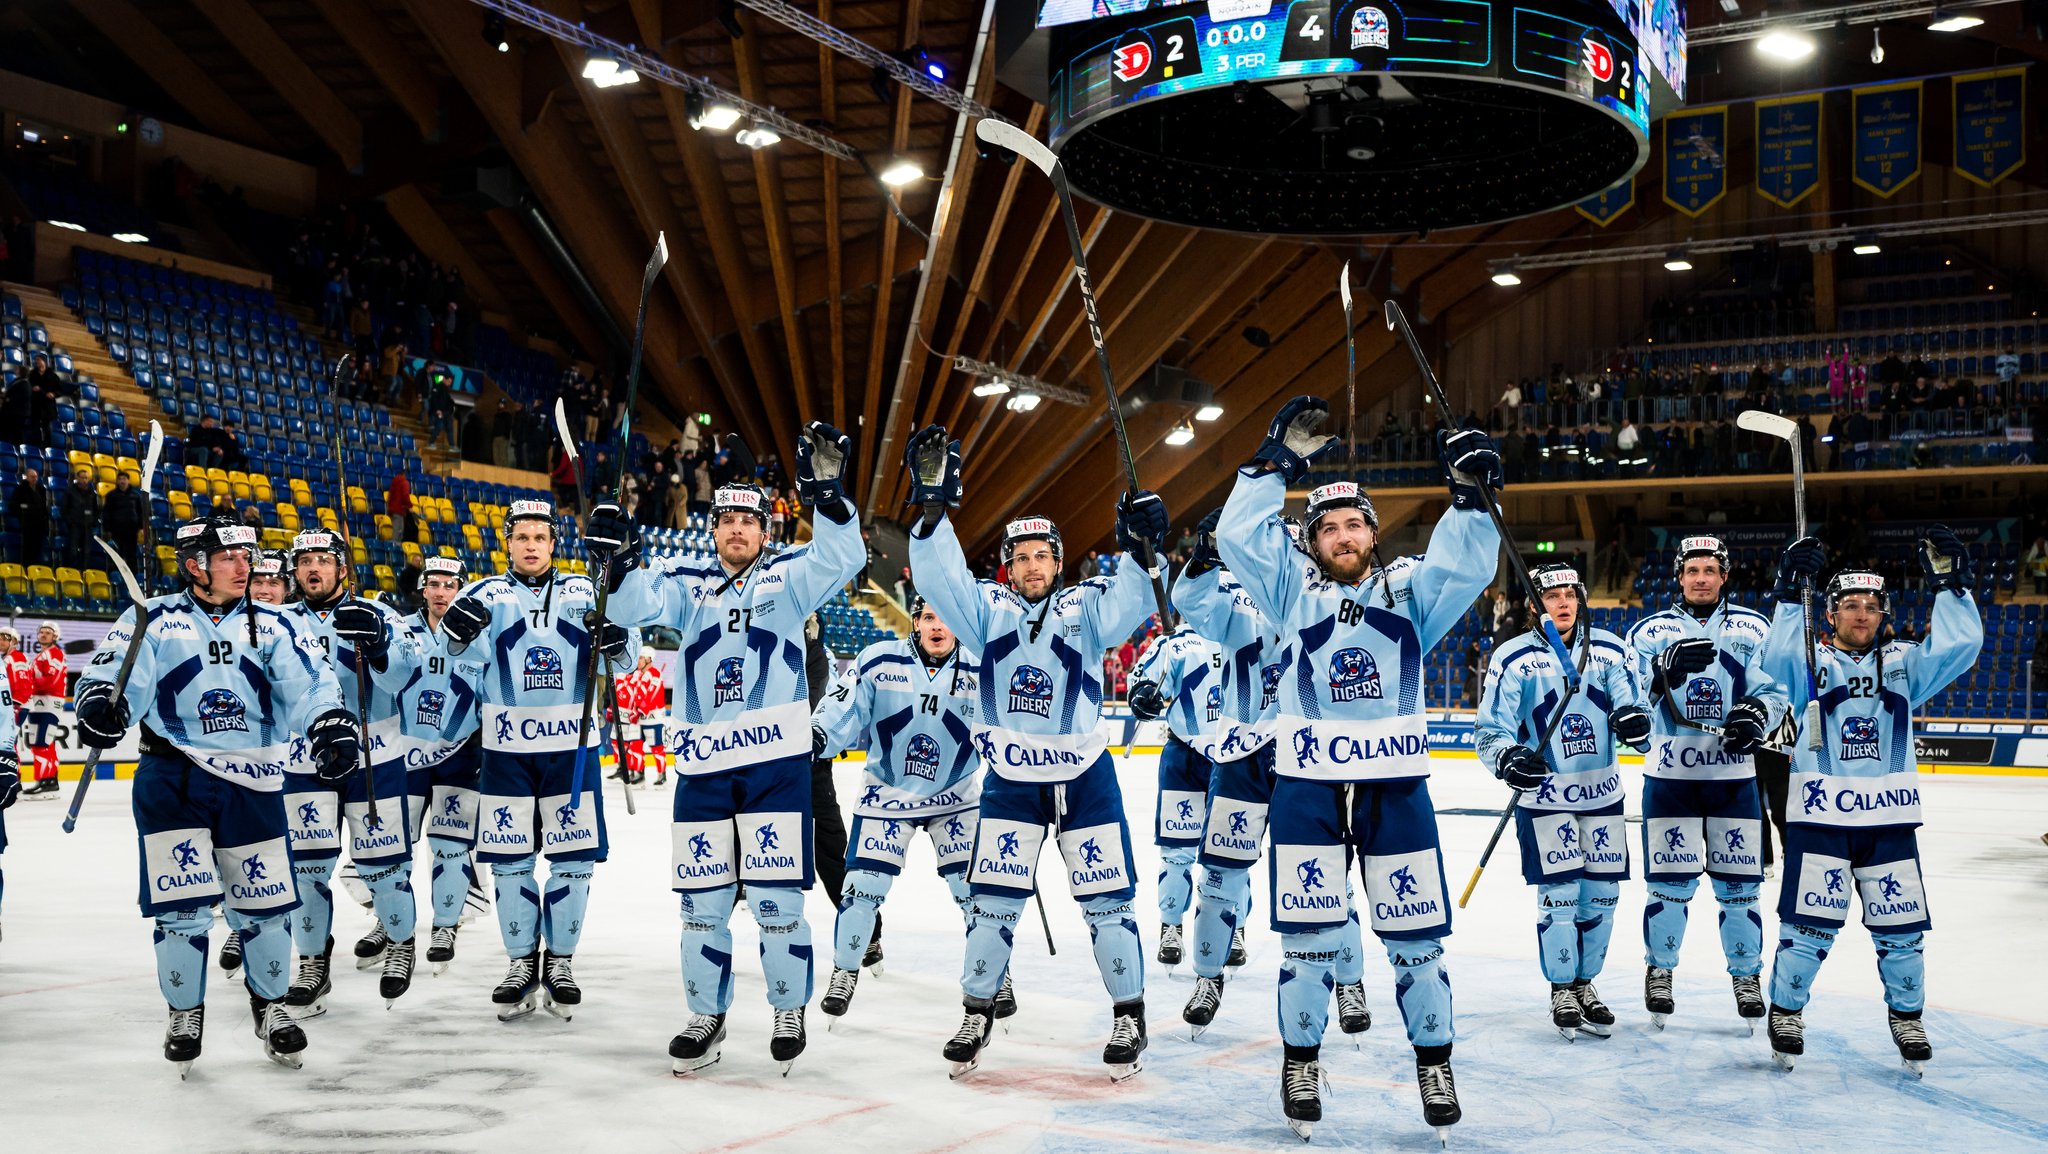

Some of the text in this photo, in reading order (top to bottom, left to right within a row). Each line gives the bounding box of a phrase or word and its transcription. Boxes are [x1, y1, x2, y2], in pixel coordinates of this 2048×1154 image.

[1207, 21, 1266, 47] 0:0.0
[1299, 15, 1324, 42] 4
[1350, 29, 1389, 48] TIGERS
[1166, 35, 1184, 62] 2
[1236, 53, 1265, 69] PER
[1621, 61, 1631, 89] 2
[1883, 137, 1890, 149] 7
[1784, 149, 1792, 161] 2
[1691, 159, 1698, 170] 4
[1880, 160, 1892, 173] 12
[1784, 173, 1792, 184] 3
[1690, 183, 1698, 194] 9
[1076, 264, 1104, 349] CCM
[732, 492, 757, 504] UBS
[1327, 485, 1355, 496] UBS
[527, 502, 548, 511] UBS
[1024, 521, 1049, 531] UBS
[305, 536, 329, 545] UBS
[1695, 539, 1717, 548] UBS
[1737, 531, 1786, 540] CUP DAVOS
[264, 560, 278, 570] BS
[438, 562, 459, 570] UBS
[755, 574, 782, 586] LANDA
[1556, 572, 1577, 582] UBS
[1857, 575, 1881, 587] UBS
[529, 609, 549, 629] 77
[728, 608, 751, 633] 27
[1338, 598, 1364, 627] 88
[209, 640, 233, 664] 92
[428, 656, 445, 674] 91
[524, 674, 563, 690] TIGERS
[1818, 667, 1827, 689] C
[1849, 676, 1873, 698] 22
[828, 684, 850, 702] 74
[1332, 679, 1379, 700] TIGERS
[920, 693, 938, 716] 74
[1009, 695, 1050, 717] TIGERS
[1687, 704, 1721, 718] TIGERS
[203, 714, 248, 734] TIGERS
[417, 711, 440, 729] TIGER
[1730, 703, 1766, 728] AUER
[521, 717, 596, 741] CALANA
[1428, 732, 1475, 744] nker St
[695, 724, 784, 761] CALANDA
[1329, 734, 1430, 764] CALANDA
[1563, 738, 1596, 756] TIGERS
[1843, 742, 1879, 759] TIGERS
[1681, 746, 1745, 768] CALAND
[1915, 747, 1949, 757] QAIN
[905, 760, 937, 780] TIGERS
[1835, 788, 1921, 813] CALANDA
[431, 815, 469, 830] CALANDA
[289, 828, 400, 851] CALANDA CALANDA
[482, 828, 591, 845] CALANDA CALANDA
[1211, 832, 1256, 850] CALANDA
[864, 837, 904, 858] CALANDA
[677, 854, 795, 879] CALANDA CALANDA
[1654, 850, 1756, 866] CALANDA CALANDA
[359, 863, 402, 883] CHSNER
[979, 858, 1121, 886] CALANDA CALANDA
[157, 871, 287, 900] CALANDA CALANDA
[1281, 892, 1438, 920] CALANDA CALANDA
[1804, 891, 1919, 917] CALANDA CALANDA
